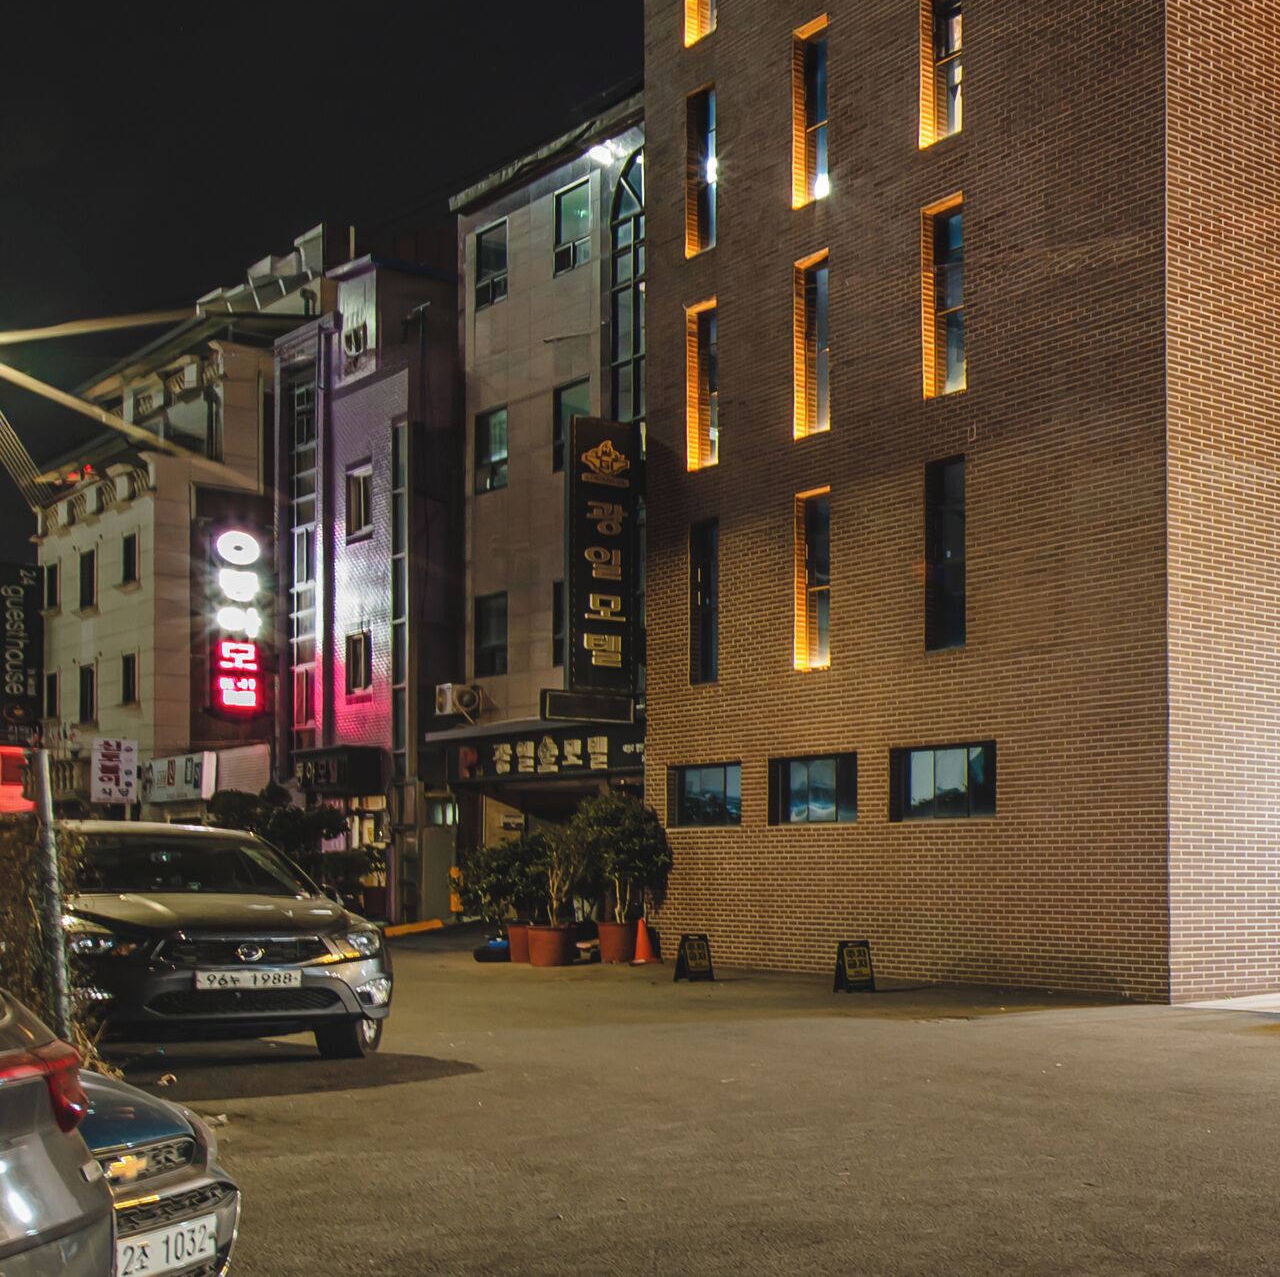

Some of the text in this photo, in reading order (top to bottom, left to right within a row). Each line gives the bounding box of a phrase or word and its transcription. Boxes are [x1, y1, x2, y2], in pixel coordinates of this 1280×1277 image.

[1, 585, 28, 695] guesthouse
[251, 972, 293, 986] 1988
[161, 1223, 207, 1264] 1032
